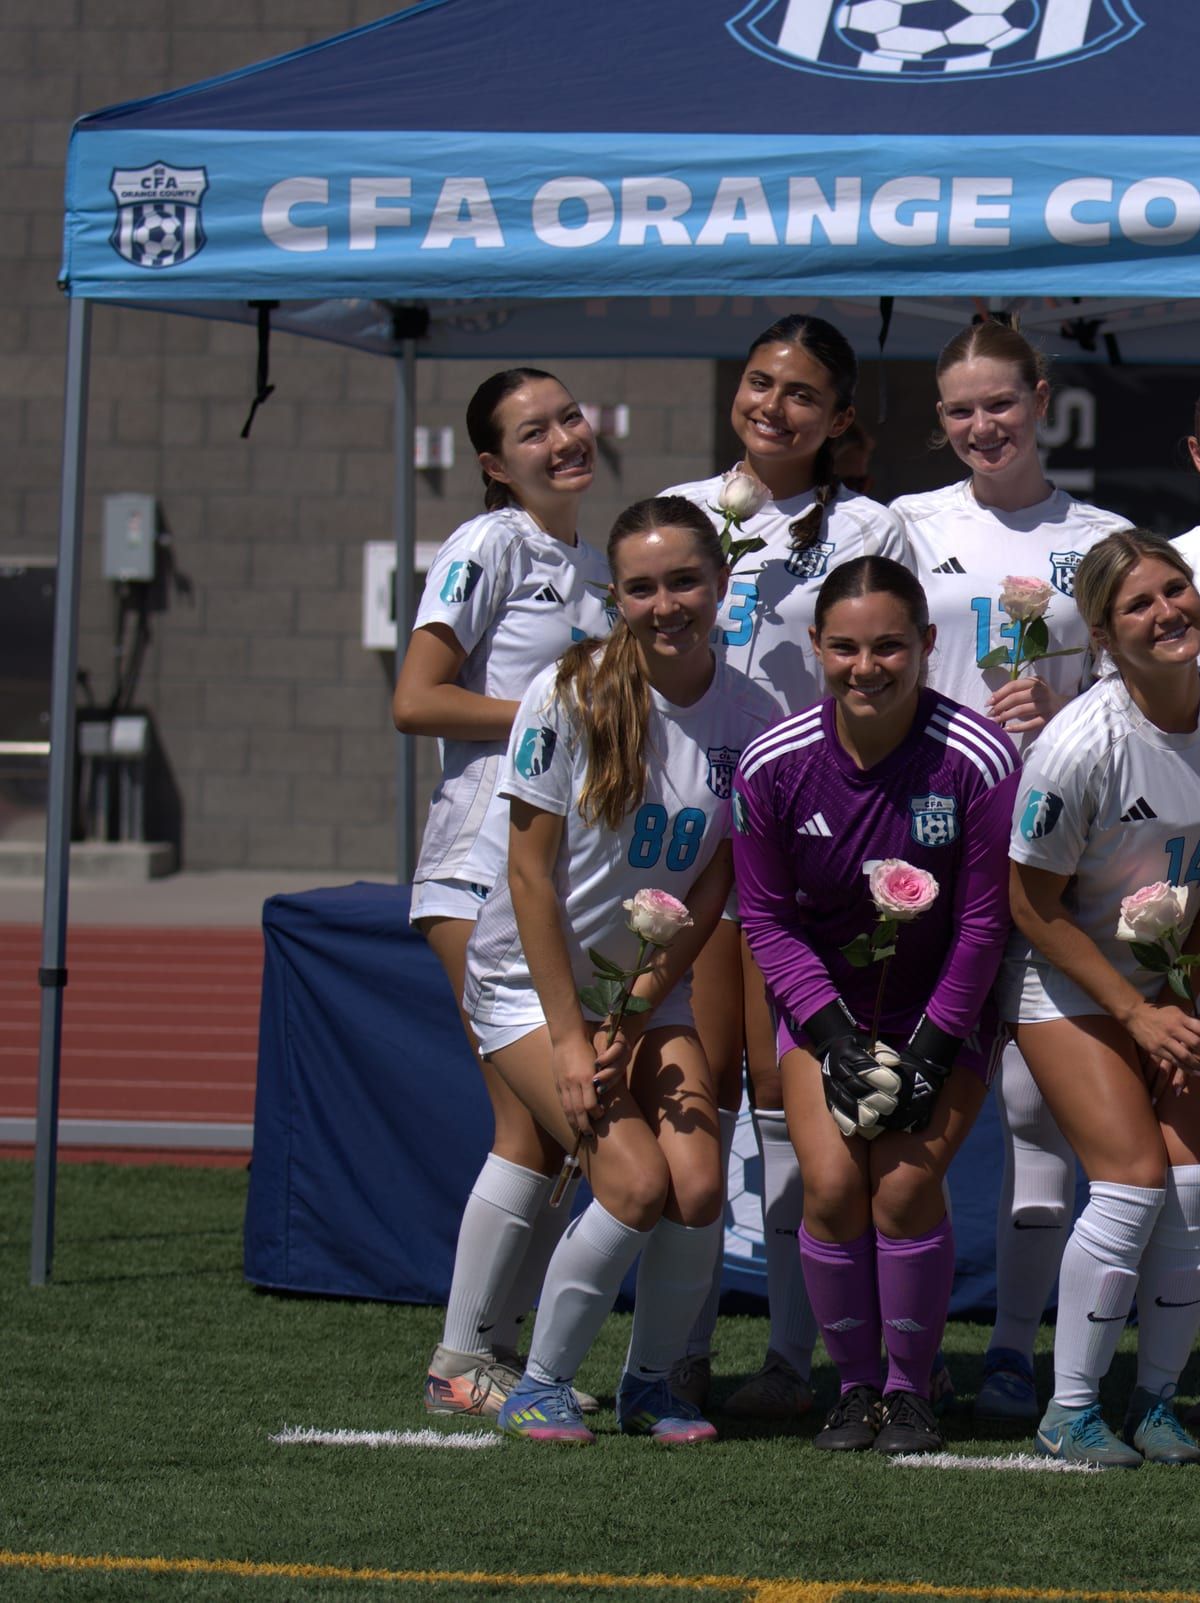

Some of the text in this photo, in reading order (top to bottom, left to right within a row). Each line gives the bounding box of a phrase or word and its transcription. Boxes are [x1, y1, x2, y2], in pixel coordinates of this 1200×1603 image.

[141, 177, 178, 189] CFA
[261, 176, 505, 252] CFA
[531, 175, 1014, 248] ORANGE
[709, 582, 759, 646] 3
[628, 803, 707, 872] 88
